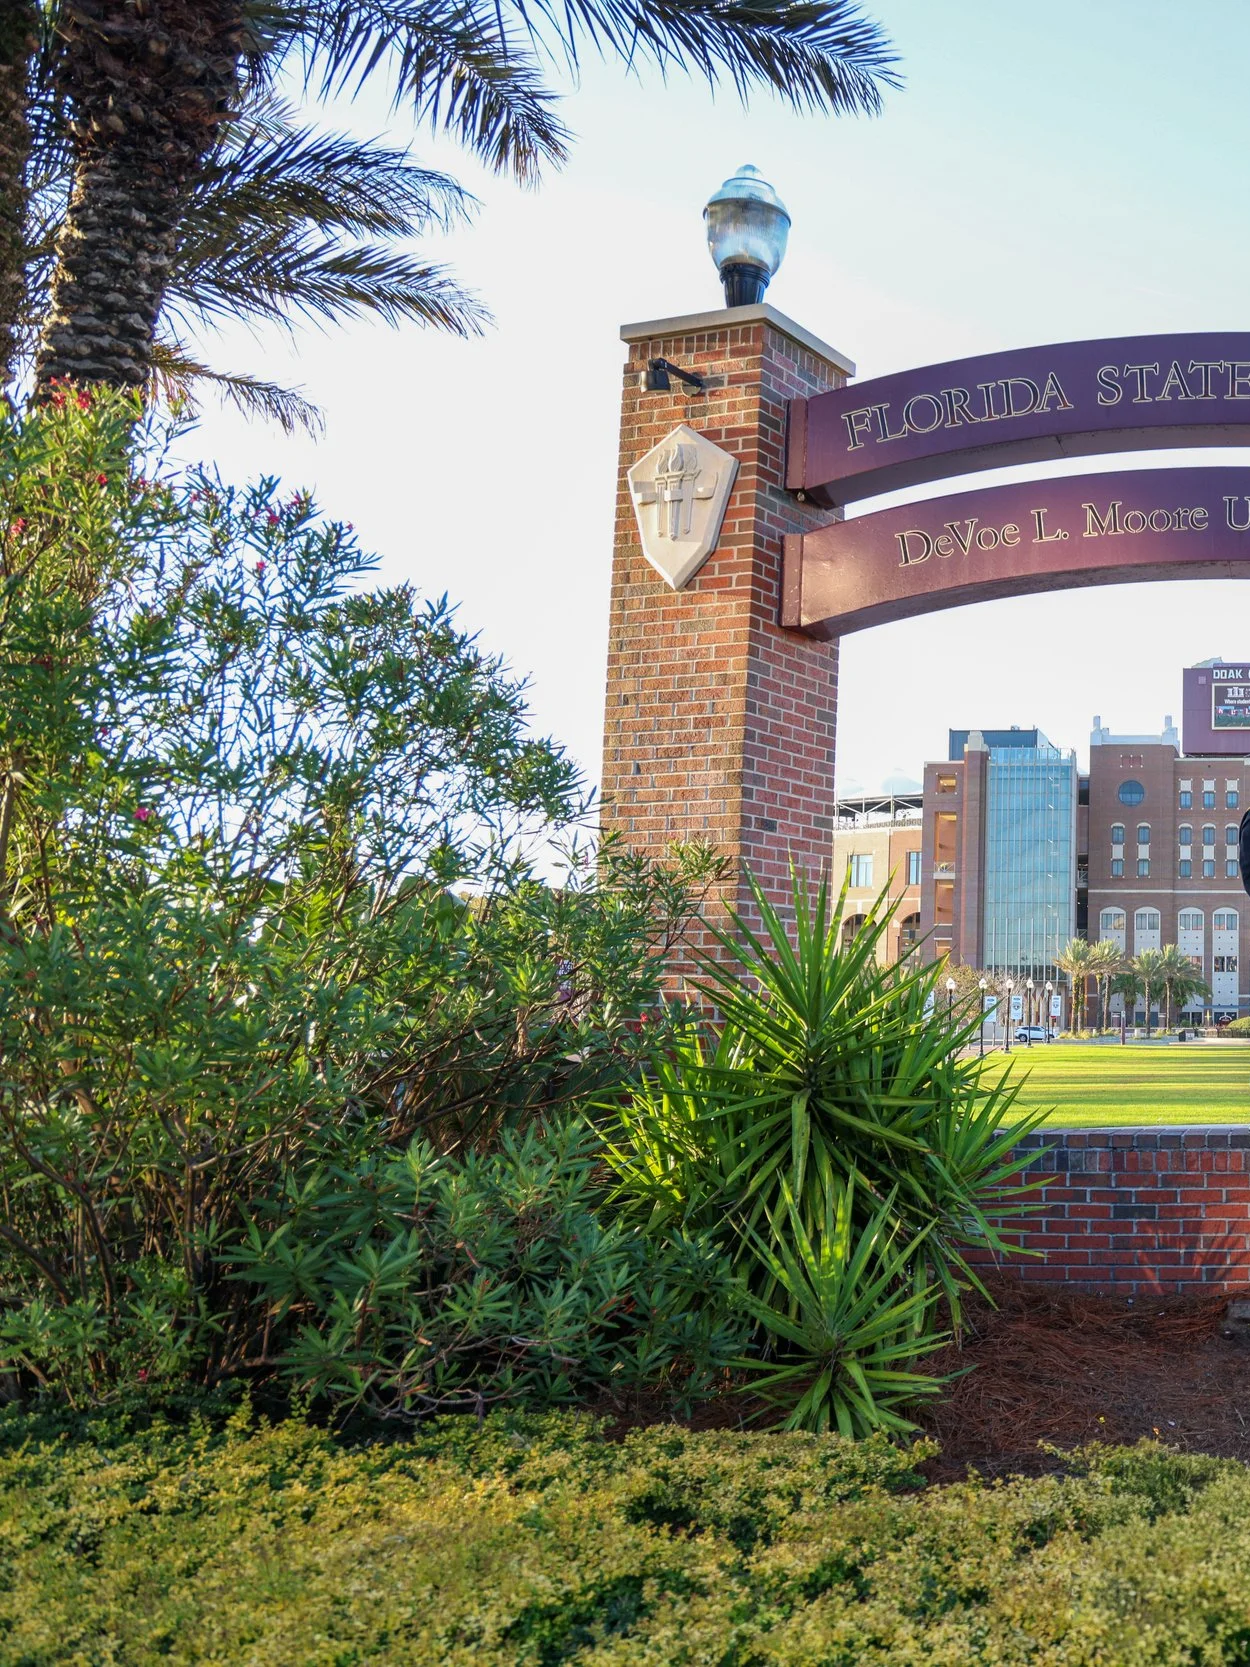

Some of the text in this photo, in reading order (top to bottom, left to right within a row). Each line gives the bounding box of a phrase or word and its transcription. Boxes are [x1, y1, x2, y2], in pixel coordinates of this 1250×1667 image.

[841, 371, 1074, 451] FLORIDA
[894, 518, 1020, 567] DeVoe
[1031, 508, 1070, 543] L.
[1082, 501, 1209, 537] Moore
[1212, 669, 1243, 680] DOAK
